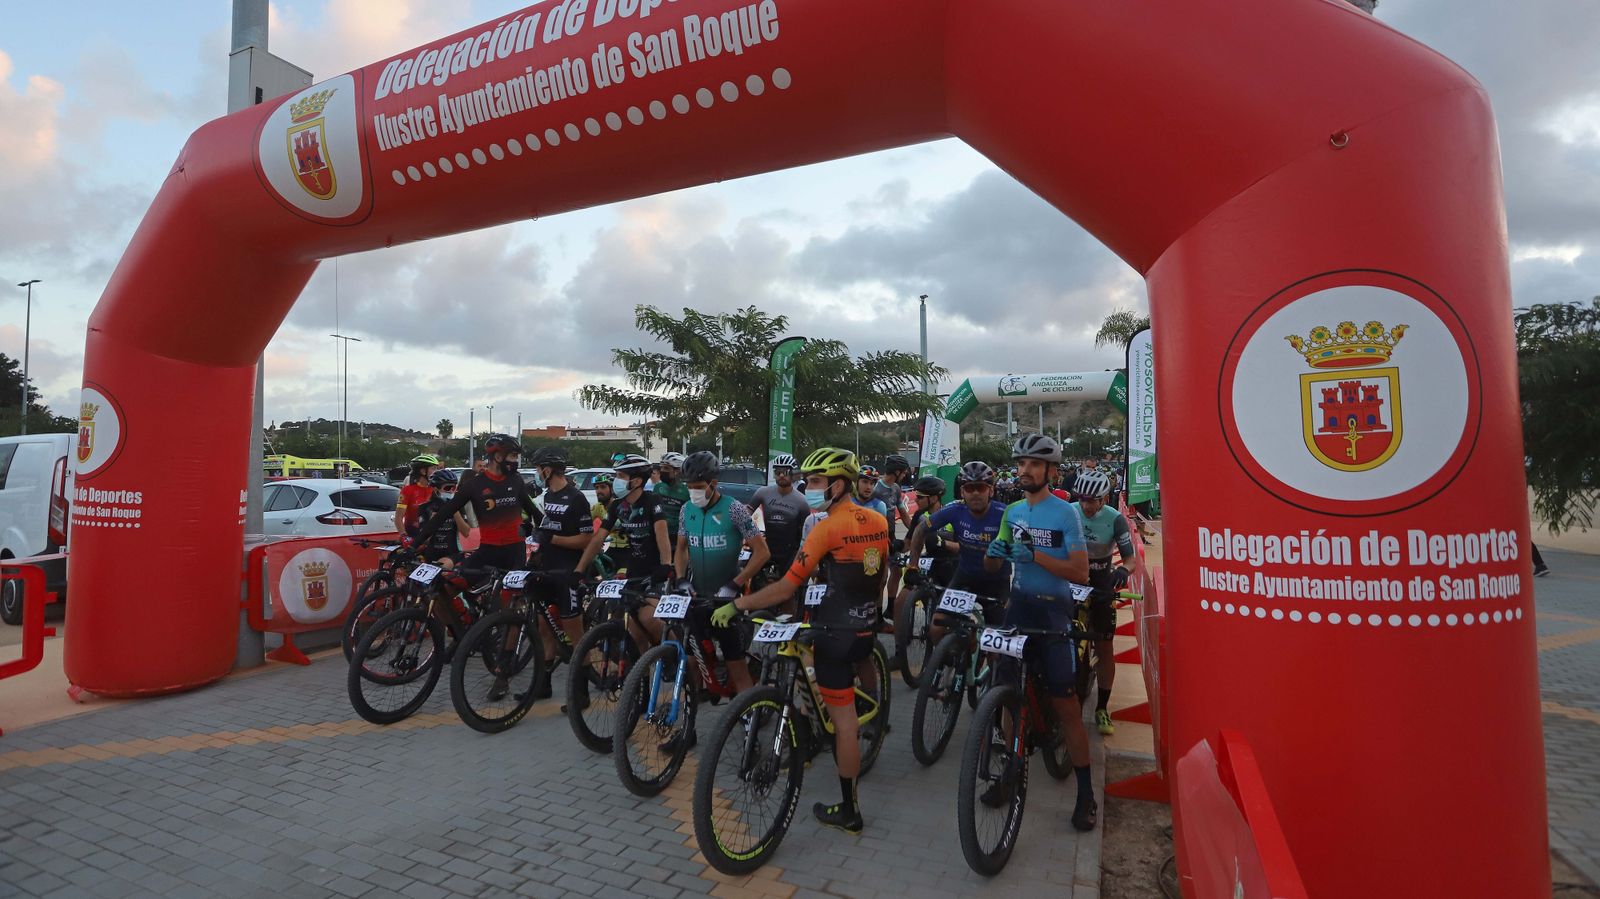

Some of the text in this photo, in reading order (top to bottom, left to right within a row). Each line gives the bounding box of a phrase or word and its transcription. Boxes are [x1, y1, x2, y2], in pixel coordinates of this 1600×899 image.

[375, 13, 541, 100] Delegación
[543, 0, 588, 44] de
[374, 104, 438, 152] Ilustre
[439, 57, 589, 135] Ayuntamiento
[593, 43, 625, 89] de
[628, 27, 681, 79] San
[683, 0, 780, 63] Roque
[79, 486, 88, 501] de
[89, 487, 143, 504] Deportes
[87, 506, 95, 516] de
[96, 506, 111, 517] San
[112, 507, 141, 519] Roque
[1198, 526, 1518, 568] Delegación de Deportes
[416, 568, 428, 578] 61
[1200, 566, 1520, 602] Ilustre Ayuntamiento de San Roque
[657, 603, 679, 613] 328
[943, 596, 966, 609] 302
[759, 630, 786, 638] 381
[983, 634, 1011, 651] 201
